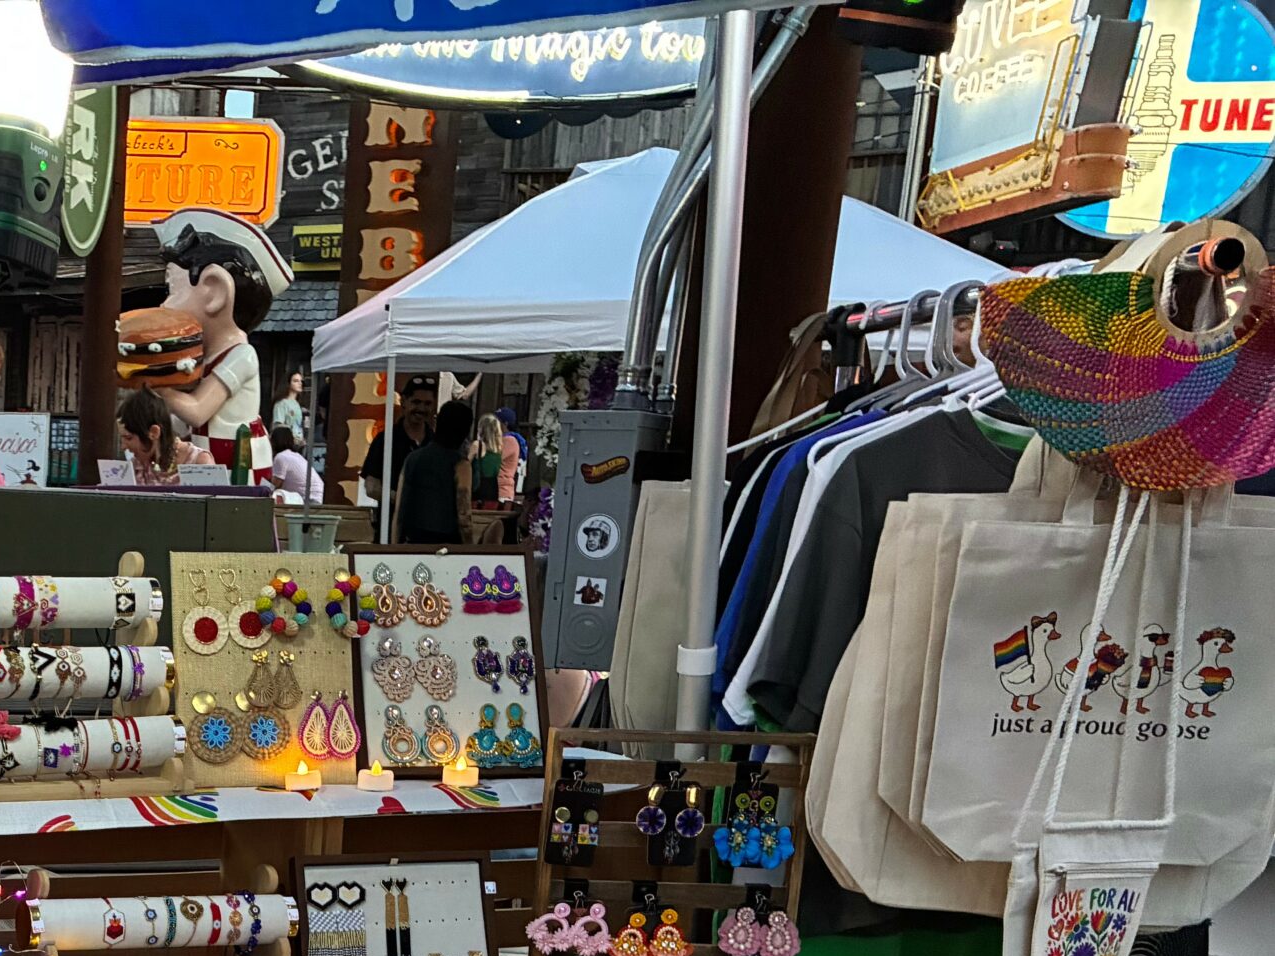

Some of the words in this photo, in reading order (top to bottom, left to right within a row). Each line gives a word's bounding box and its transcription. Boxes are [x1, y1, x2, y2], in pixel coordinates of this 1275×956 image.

[1179, 98, 1275, 132] TUNE
[125, 162, 256, 206] TURE
[320, 179, 345, 210] S
[298, 235, 342, 248] WEST
[990, 713, 1035, 737] just
[1040, 719, 1053, 734] a
[1051, 888, 1087, 919] LOVE
[1089, 887, 1118, 911] FOR
